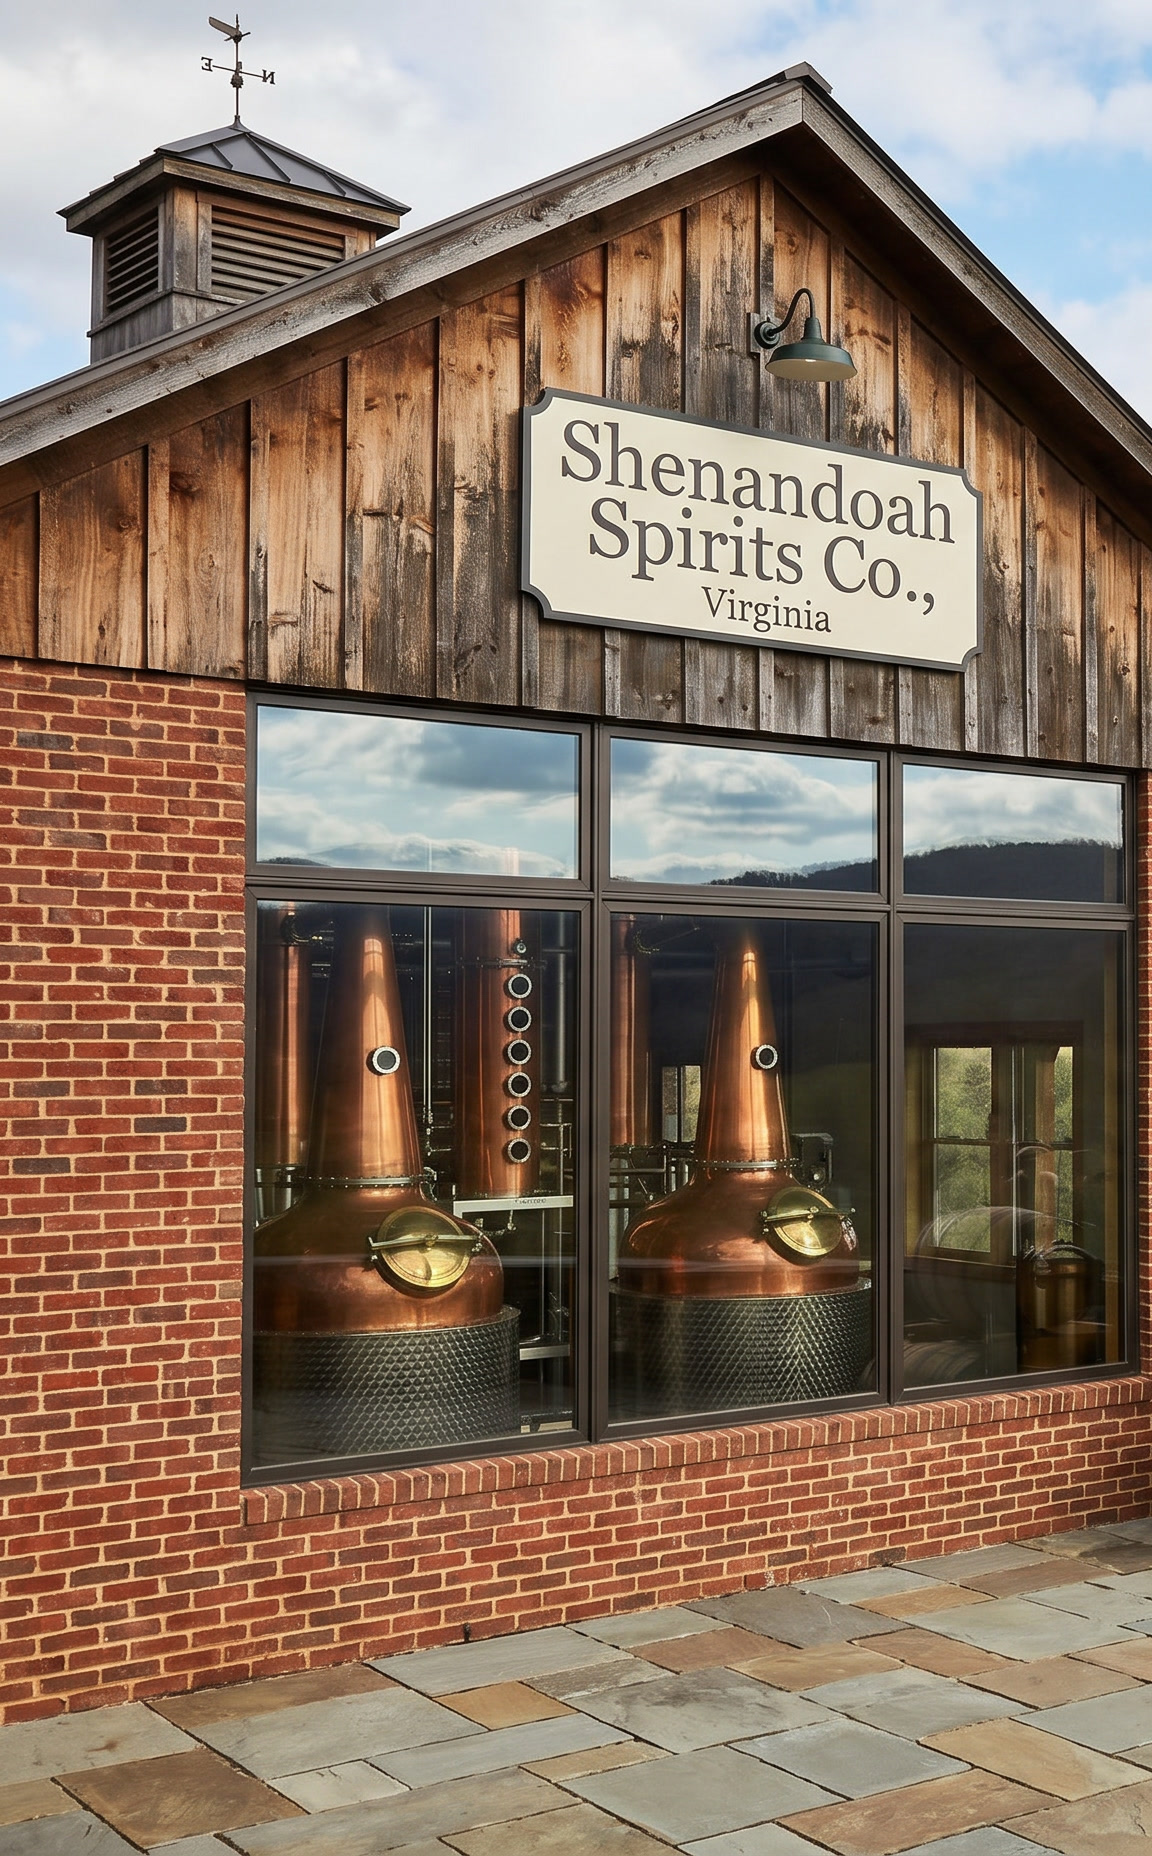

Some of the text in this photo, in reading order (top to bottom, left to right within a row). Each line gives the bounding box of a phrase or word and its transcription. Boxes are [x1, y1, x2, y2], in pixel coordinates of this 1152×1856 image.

[561, 419, 956, 544] Shenandoah
[589, 497, 935, 616] Spirits Co.,
[700, 586, 832, 633] Virginia
